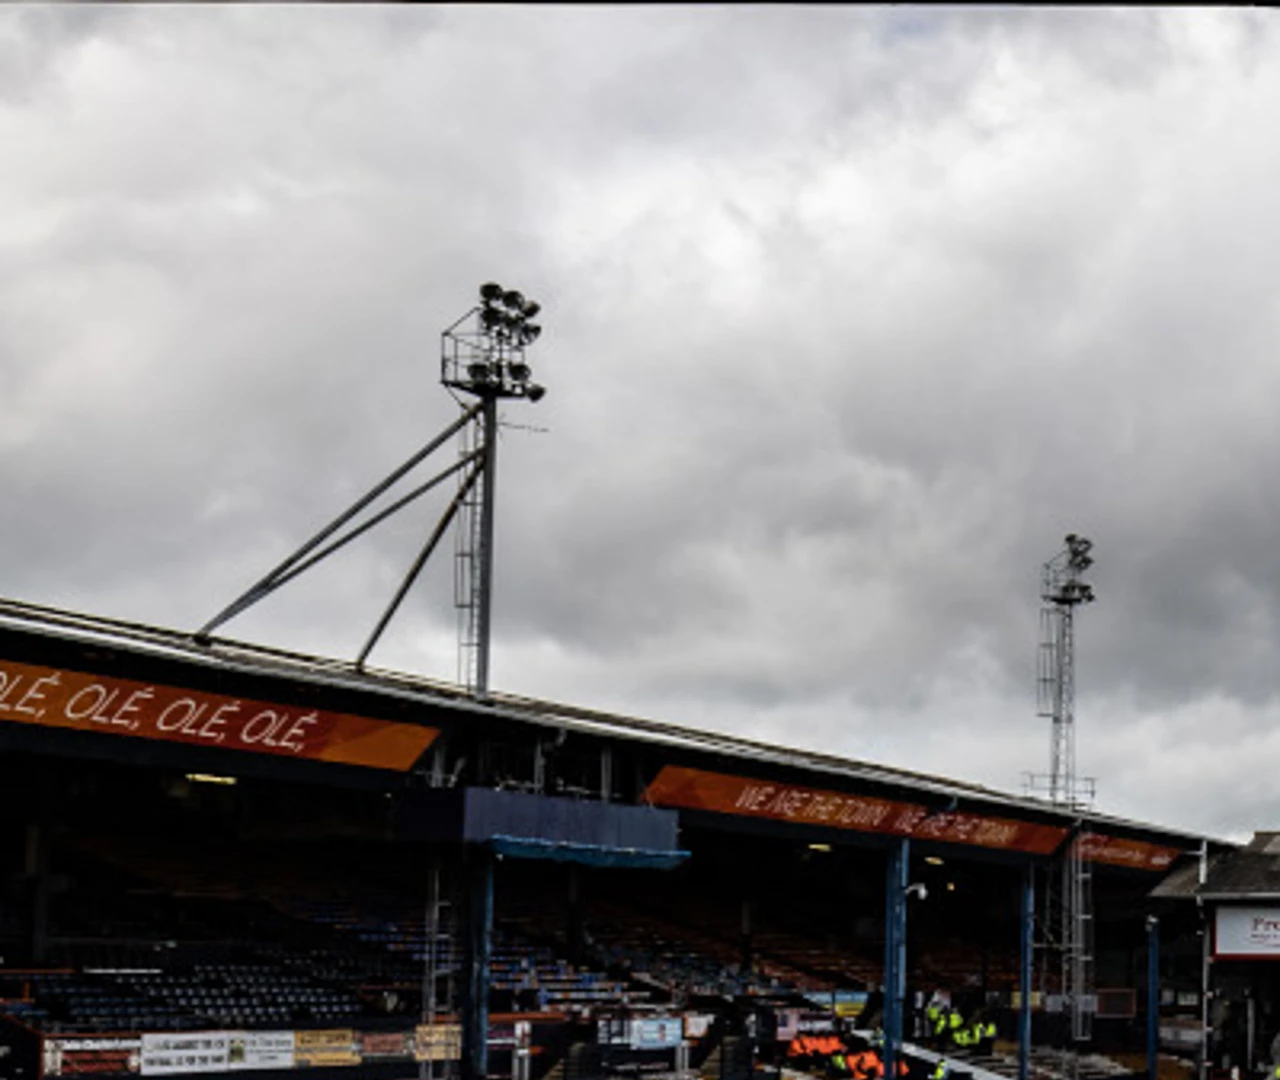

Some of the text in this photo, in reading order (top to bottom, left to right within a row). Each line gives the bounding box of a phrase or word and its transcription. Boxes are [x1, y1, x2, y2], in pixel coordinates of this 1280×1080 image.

[0, 672, 319, 754] LÉ, OLÉ, OLÉ, OLÉ,
